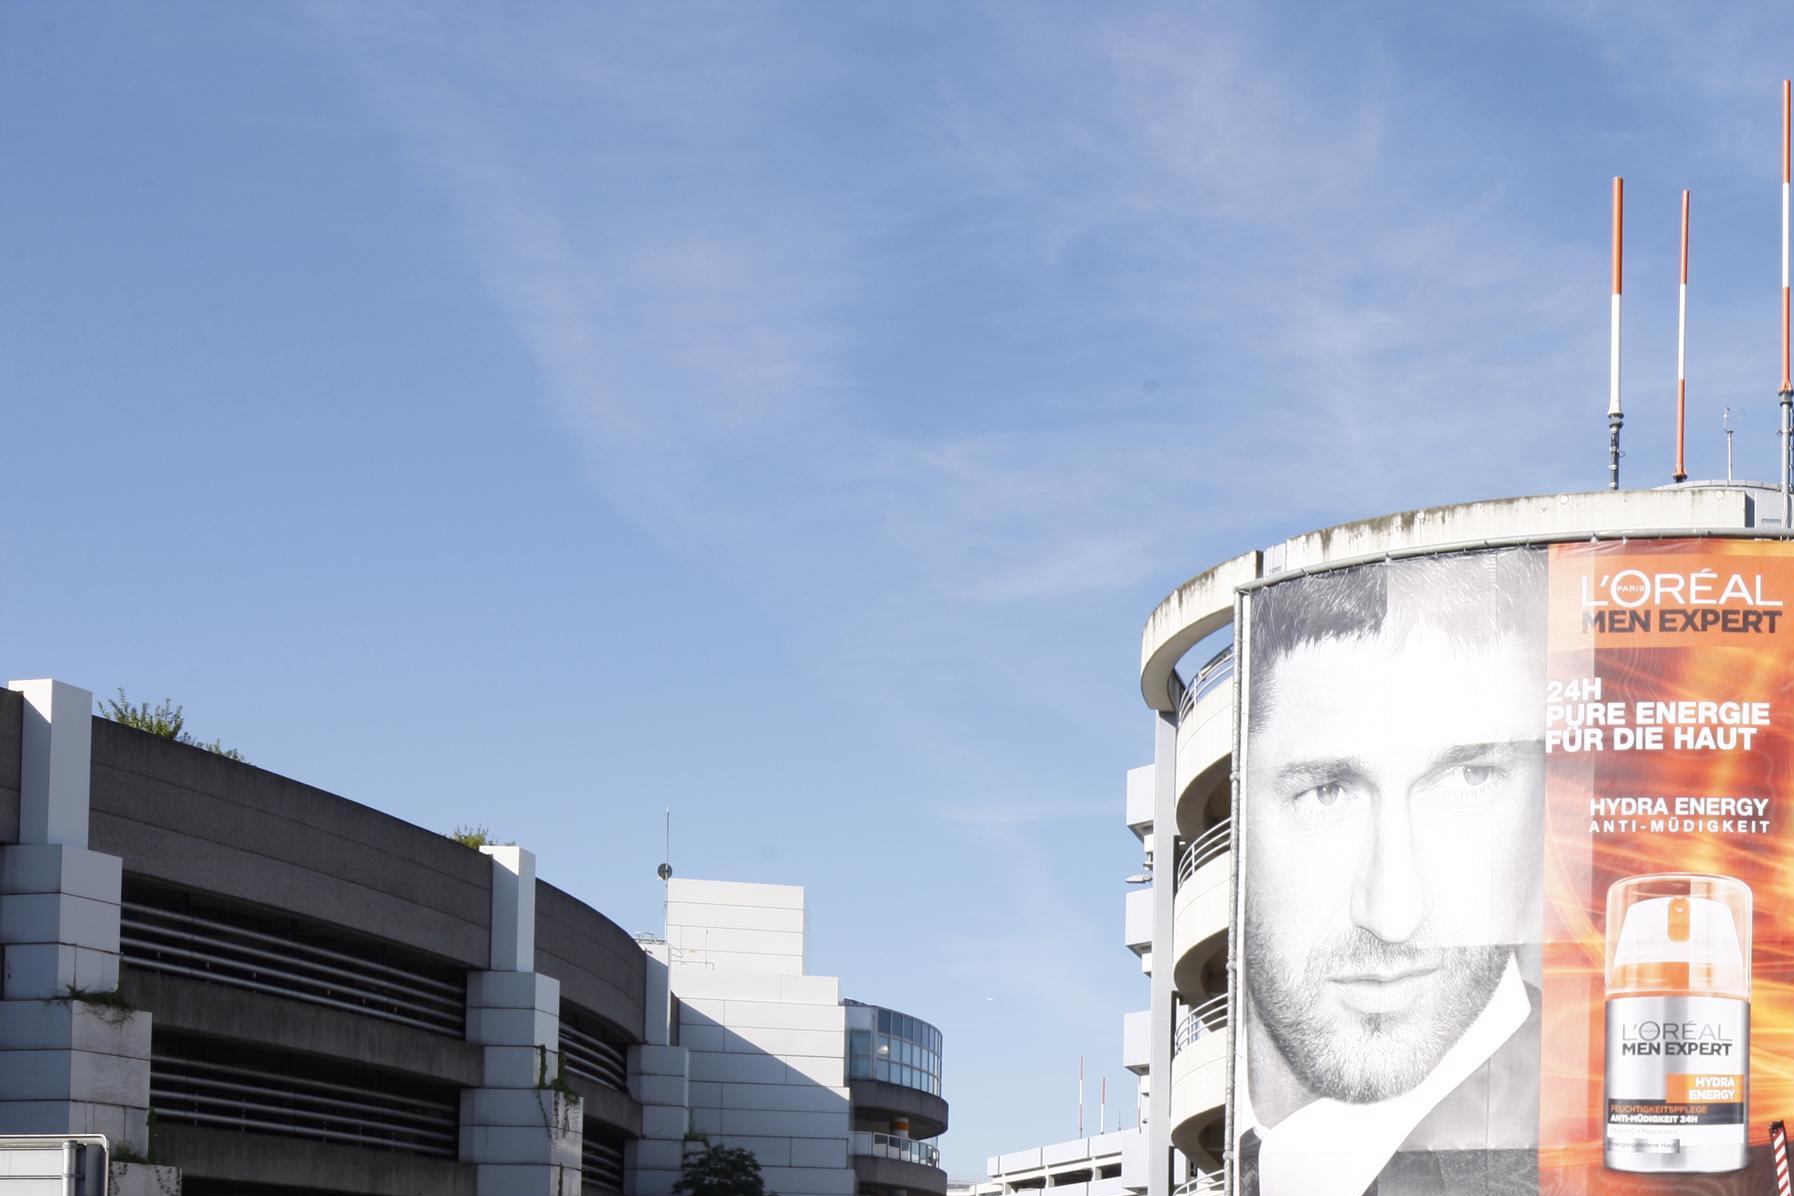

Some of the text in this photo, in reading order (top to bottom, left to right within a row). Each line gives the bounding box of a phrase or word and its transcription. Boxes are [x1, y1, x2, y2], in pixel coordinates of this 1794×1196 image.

[1582, 609, 1782, 633] MEN EXPERT
[1547, 678, 1602, 703] 24H
[1546, 702, 1770, 728] PURE ENERGIE
[1546, 726, 1758, 754] FÜR DIE HAUT
[1590, 797, 1769, 816] HYDRA ENERGY
[1589, 816, 1770, 834] ANTI-MÜDIGKEIT
[1622, 1042, 1732, 1056] MEN EXPERT
[1696, 1076, 1735, 1088] HYDRA
[1689, 1089, 1735, 1101] ENERGY
[1610, 1104, 1708, 1114] FEUCHTIGKEITSPFLEGE
[1610, 1113, 1698, 1123] ANTI-MÜDIGKEIT 24H
